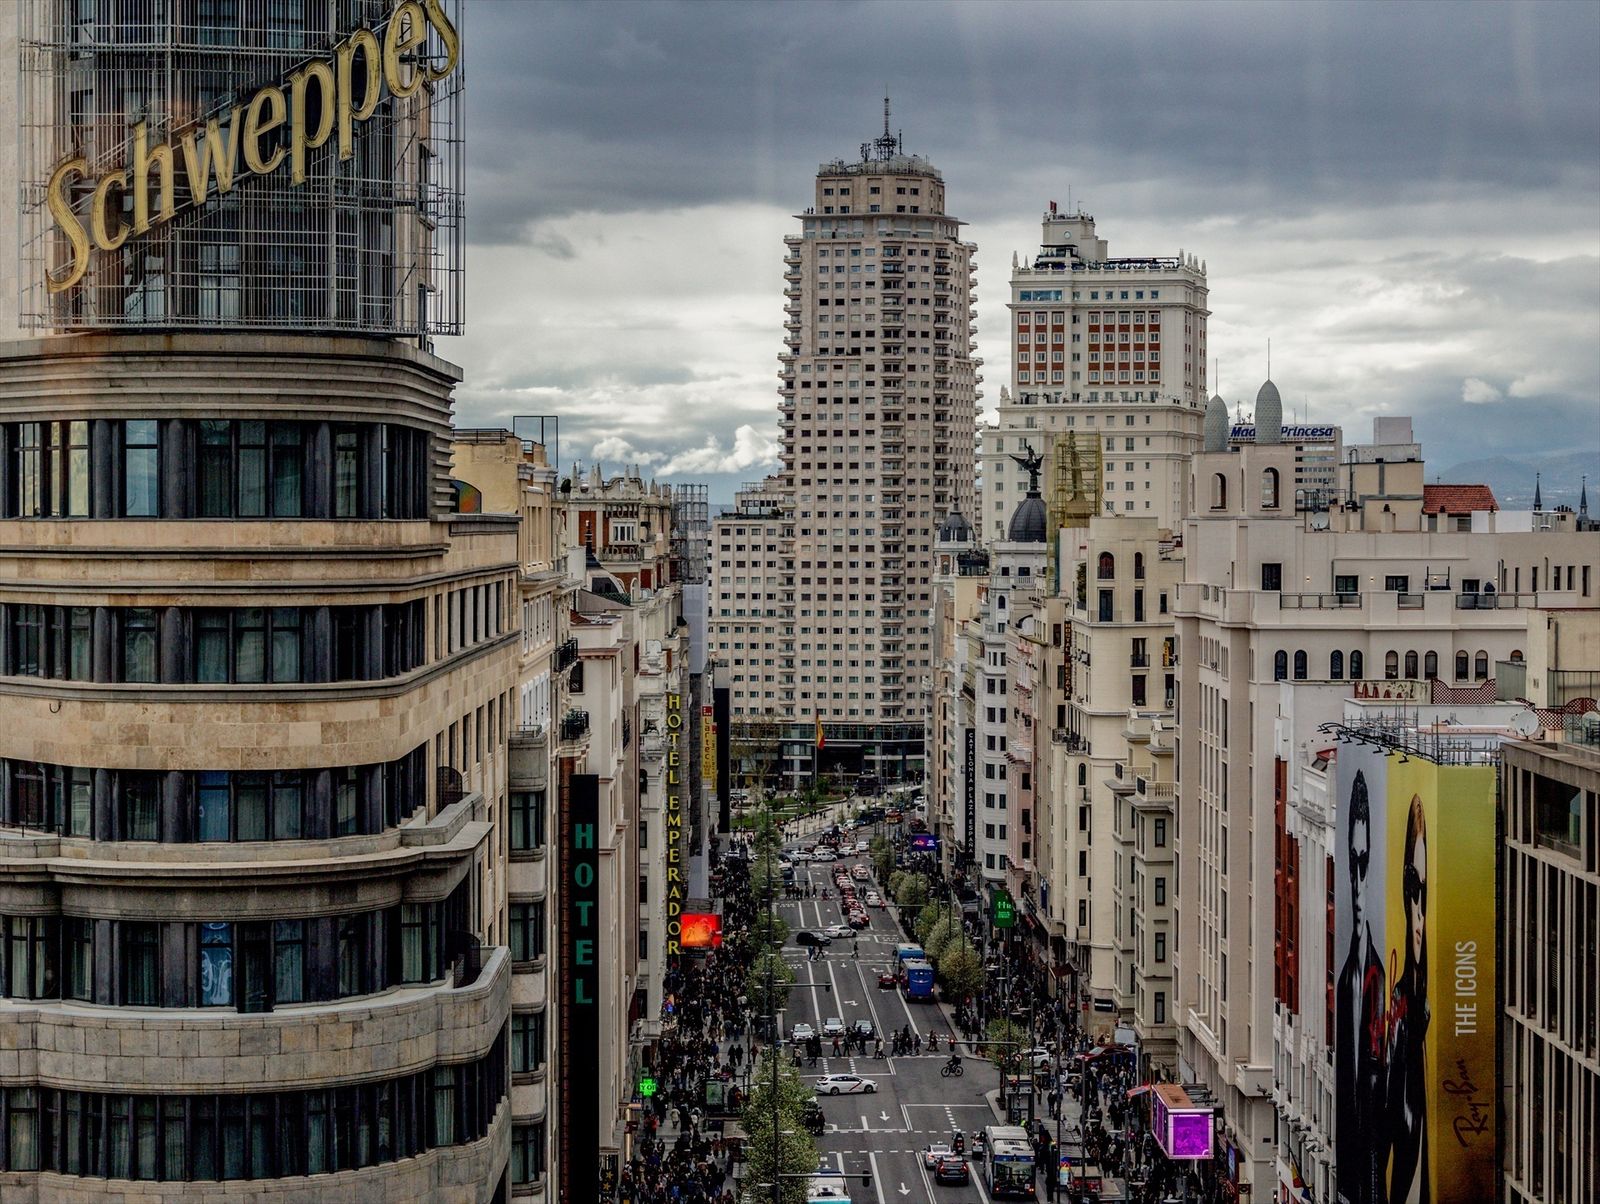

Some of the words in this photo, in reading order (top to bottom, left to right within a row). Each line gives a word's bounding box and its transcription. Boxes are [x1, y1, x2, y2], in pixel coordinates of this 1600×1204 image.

[45, 0, 459, 293] Schweppes
[1280, 426, 1333, 437] Princesa
[667, 695, 681, 784] HOTEL
[574, 823, 594, 1004] HOTEL
[667, 796, 682, 955] EMPERADOR
[1455, 940, 1477, 996] ICONS
[1455, 1003, 1477, 1037] THE
[1442, 1058, 1490, 1148] Ray-Ban
